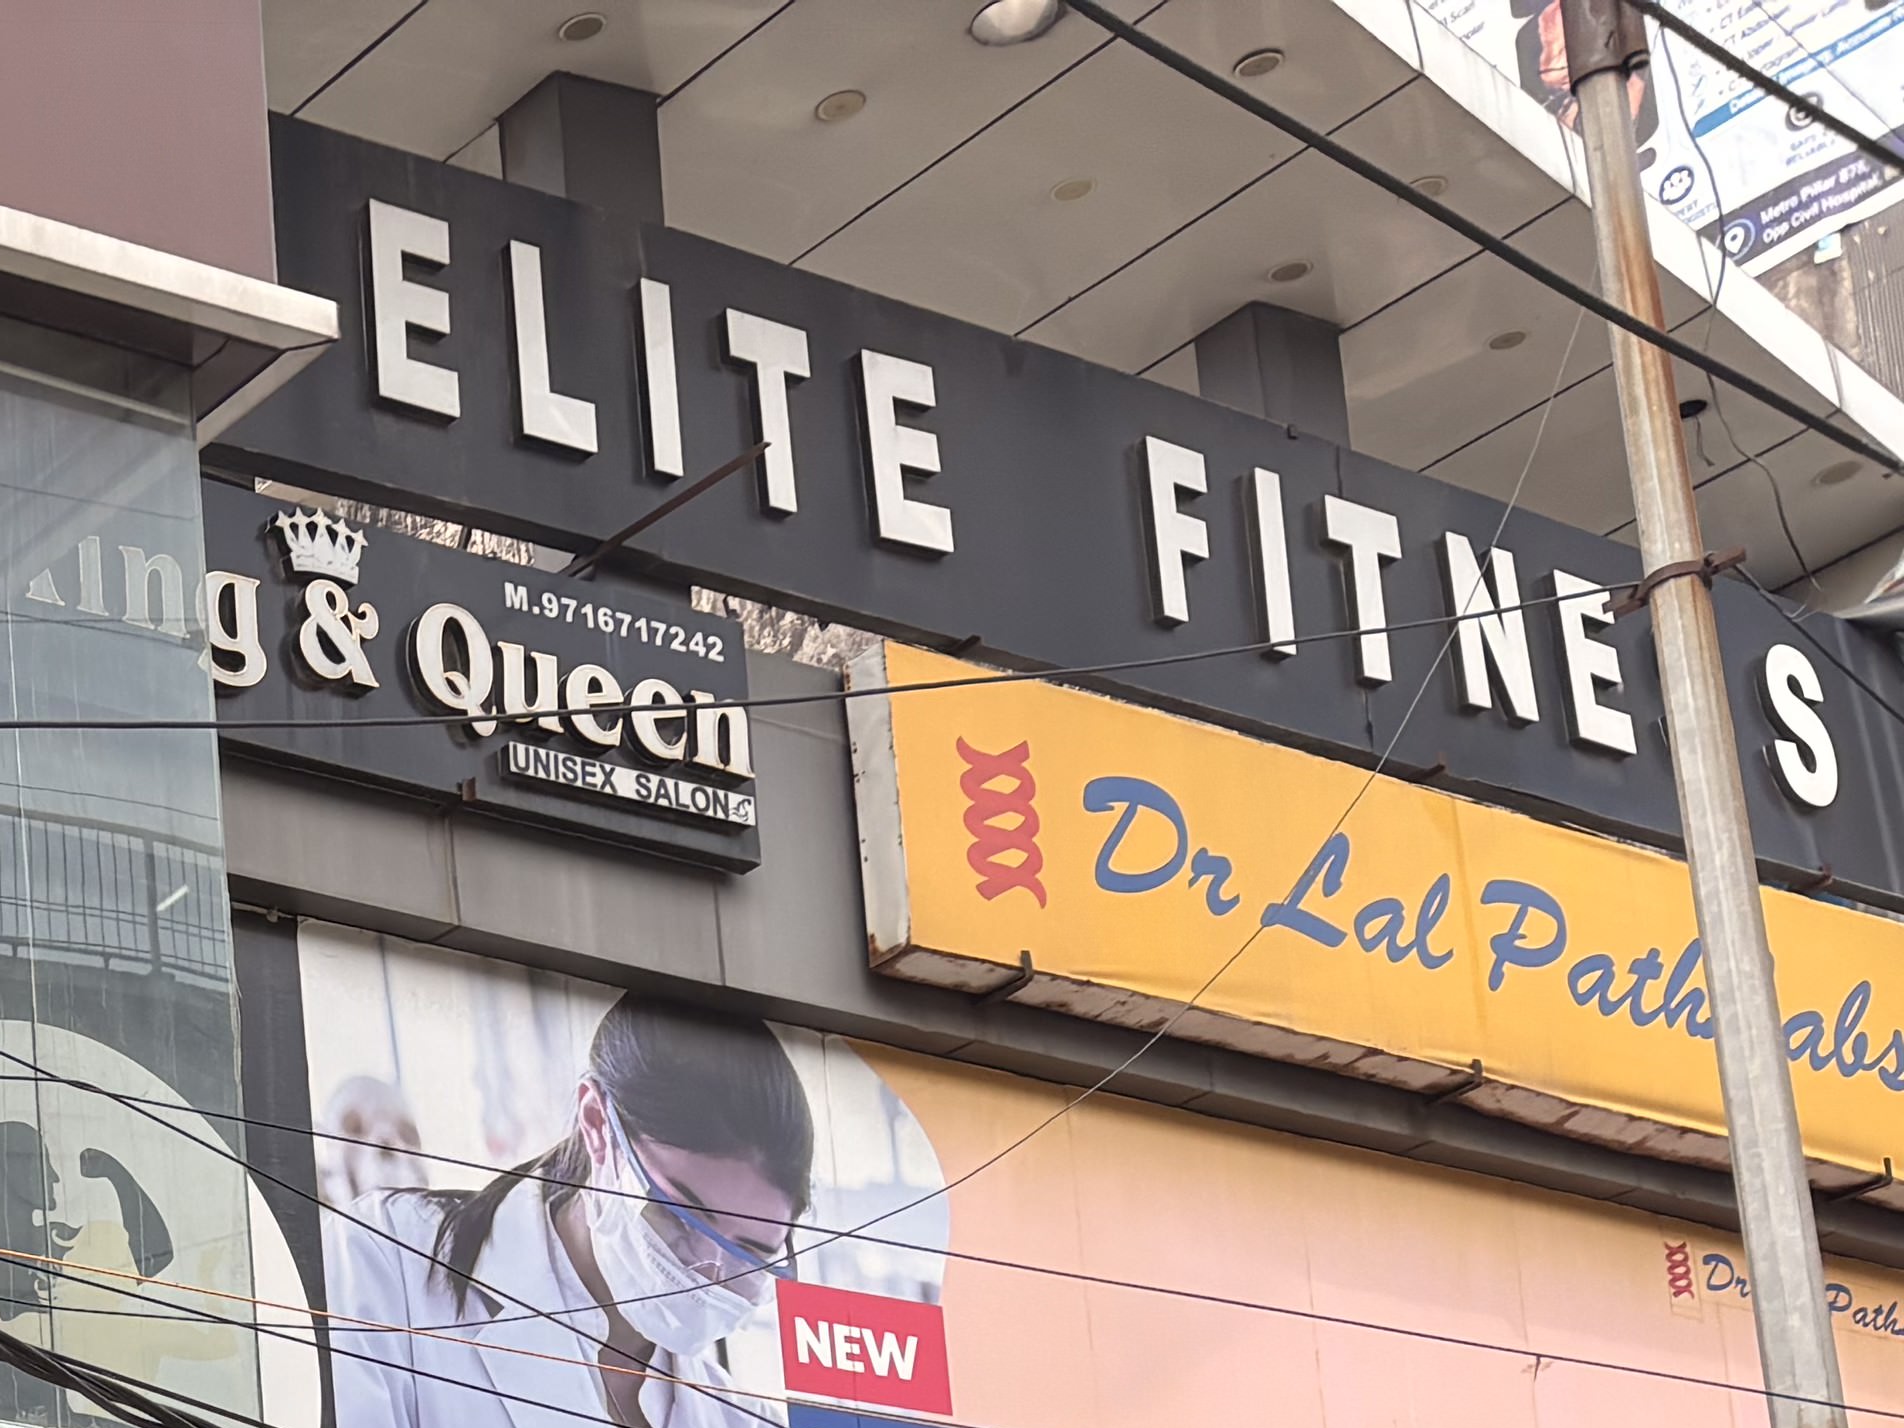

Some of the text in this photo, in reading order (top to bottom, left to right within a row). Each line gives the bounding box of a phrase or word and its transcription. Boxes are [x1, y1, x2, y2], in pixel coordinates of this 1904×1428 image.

[365, 197, 1840, 810] ELITE FITNES
[299, 578, 754, 780] & Queen
[504, 581, 725, 662] M.9716717242
[512, 743, 730, 820] UNISEX SALON
[1082, 775, 1904, 1093] Dr Lal Pathabs
[795, 1316, 918, 1381] NEW
